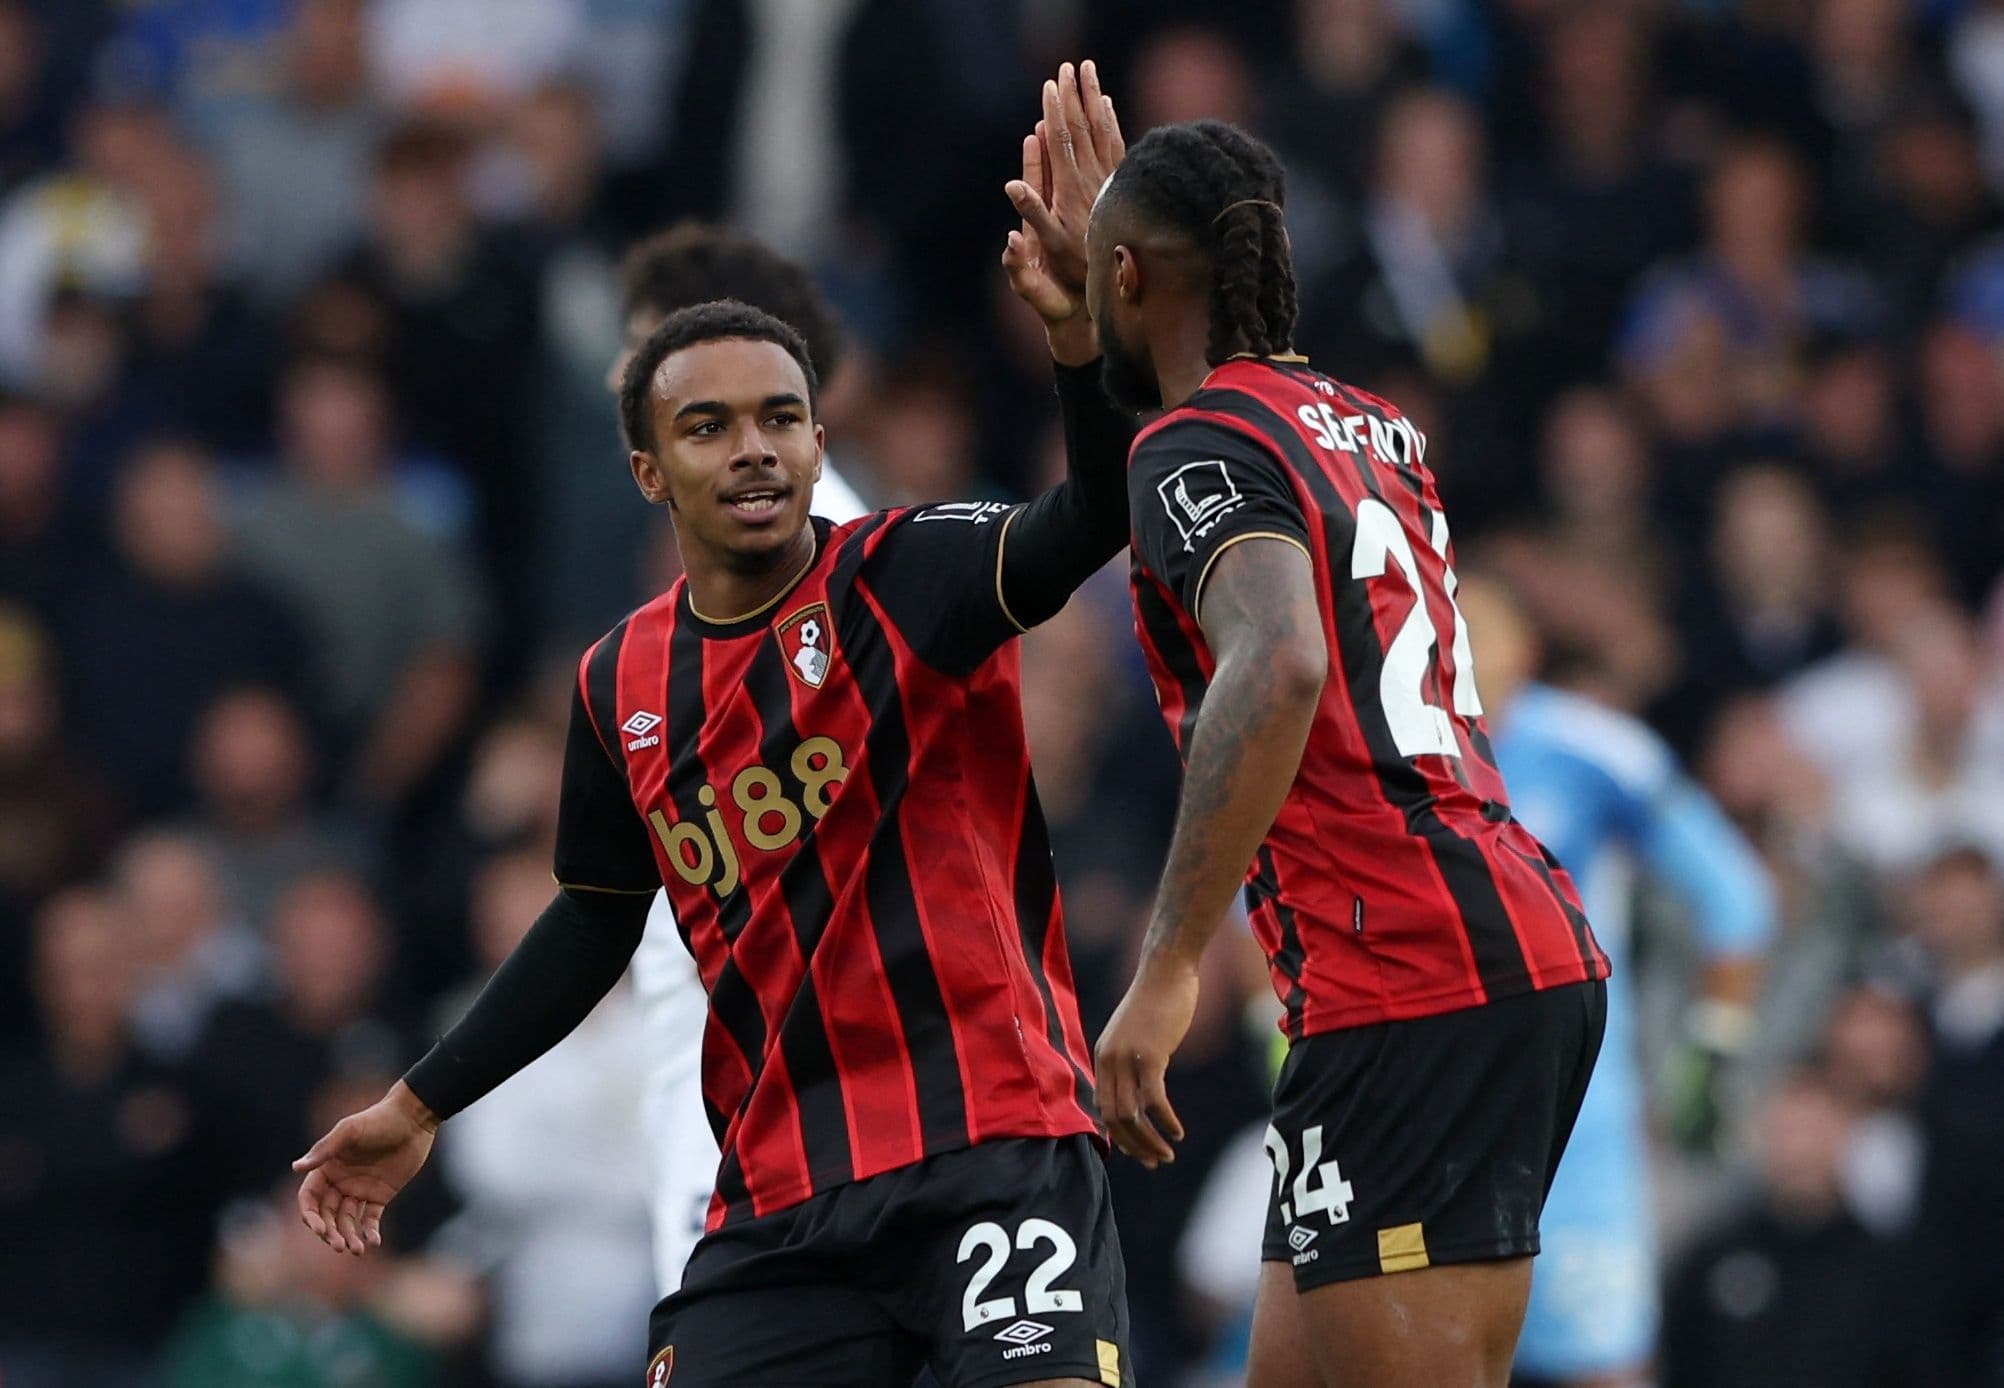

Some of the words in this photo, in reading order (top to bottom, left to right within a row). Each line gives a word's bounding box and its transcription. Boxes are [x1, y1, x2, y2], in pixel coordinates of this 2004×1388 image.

[627, 735, 660, 751] umbro
[648, 736, 850, 898] bj88
[956, 1218, 1084, 1333] 22
[1002, 1342, 1052, 1360] umbro
